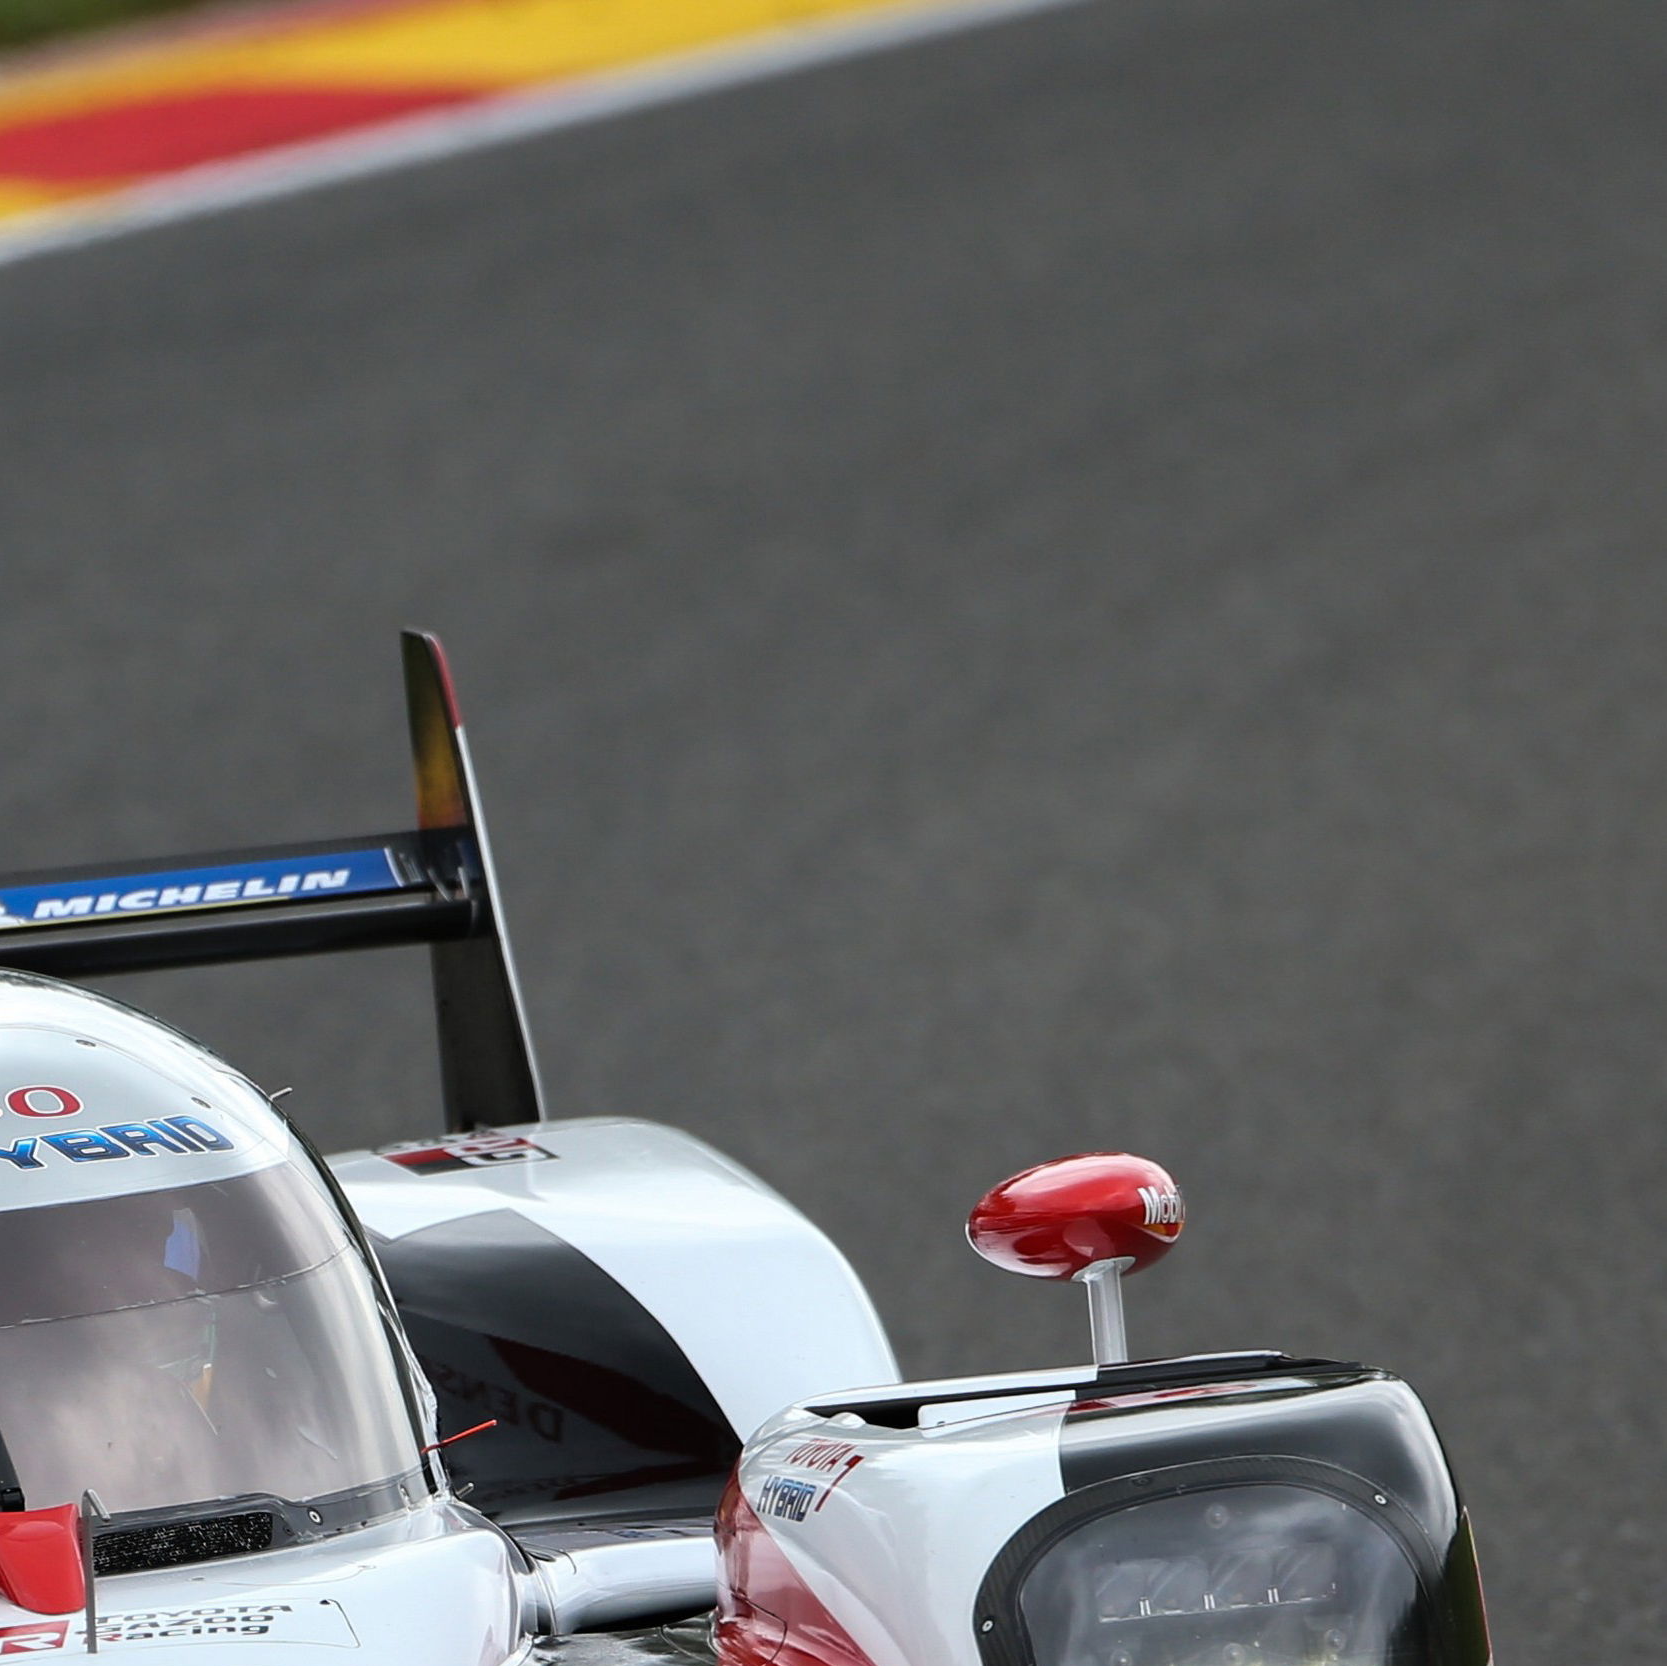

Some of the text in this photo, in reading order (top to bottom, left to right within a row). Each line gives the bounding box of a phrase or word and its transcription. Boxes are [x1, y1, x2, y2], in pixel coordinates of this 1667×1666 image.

[34, 869, 350, 919] MICHELIN
[783, 1438, 858, 1472] TOYOTA
[756, 1474, 817, 1522] HYBRID
[74, 1615, 274, 1636] GAZOO
[87, 1604, 293, 1625] TOYOTA
[82, 1625, 271, 1645] Racing
